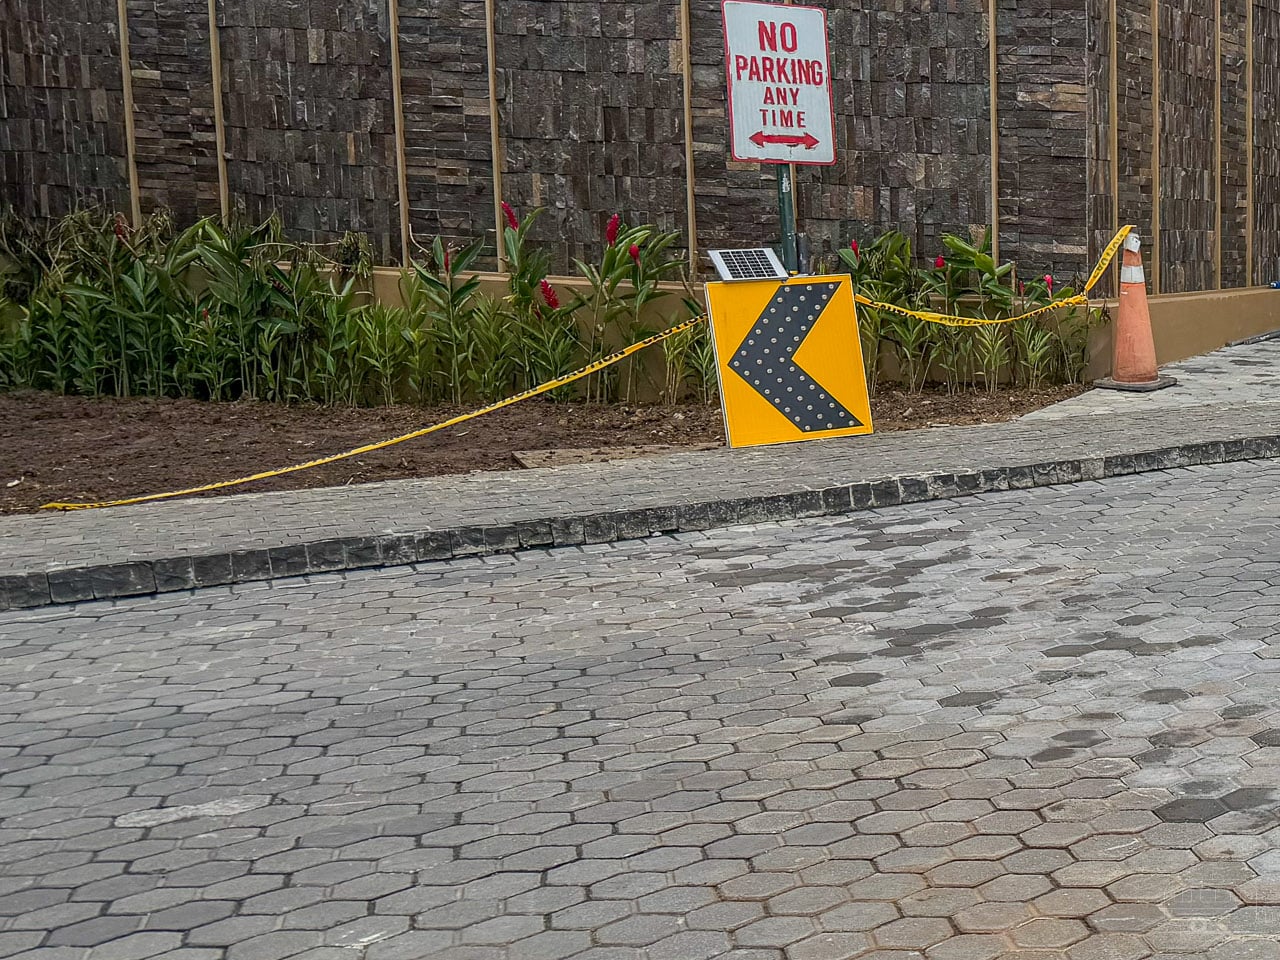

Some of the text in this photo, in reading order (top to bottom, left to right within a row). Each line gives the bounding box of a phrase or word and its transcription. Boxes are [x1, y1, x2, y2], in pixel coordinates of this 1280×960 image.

[758, 20, 798, 53] NO
[735, 55, 824, 86] PARKING
[763, 86, 800, 106] ANY
[760, 109, 807, 128] TIME
